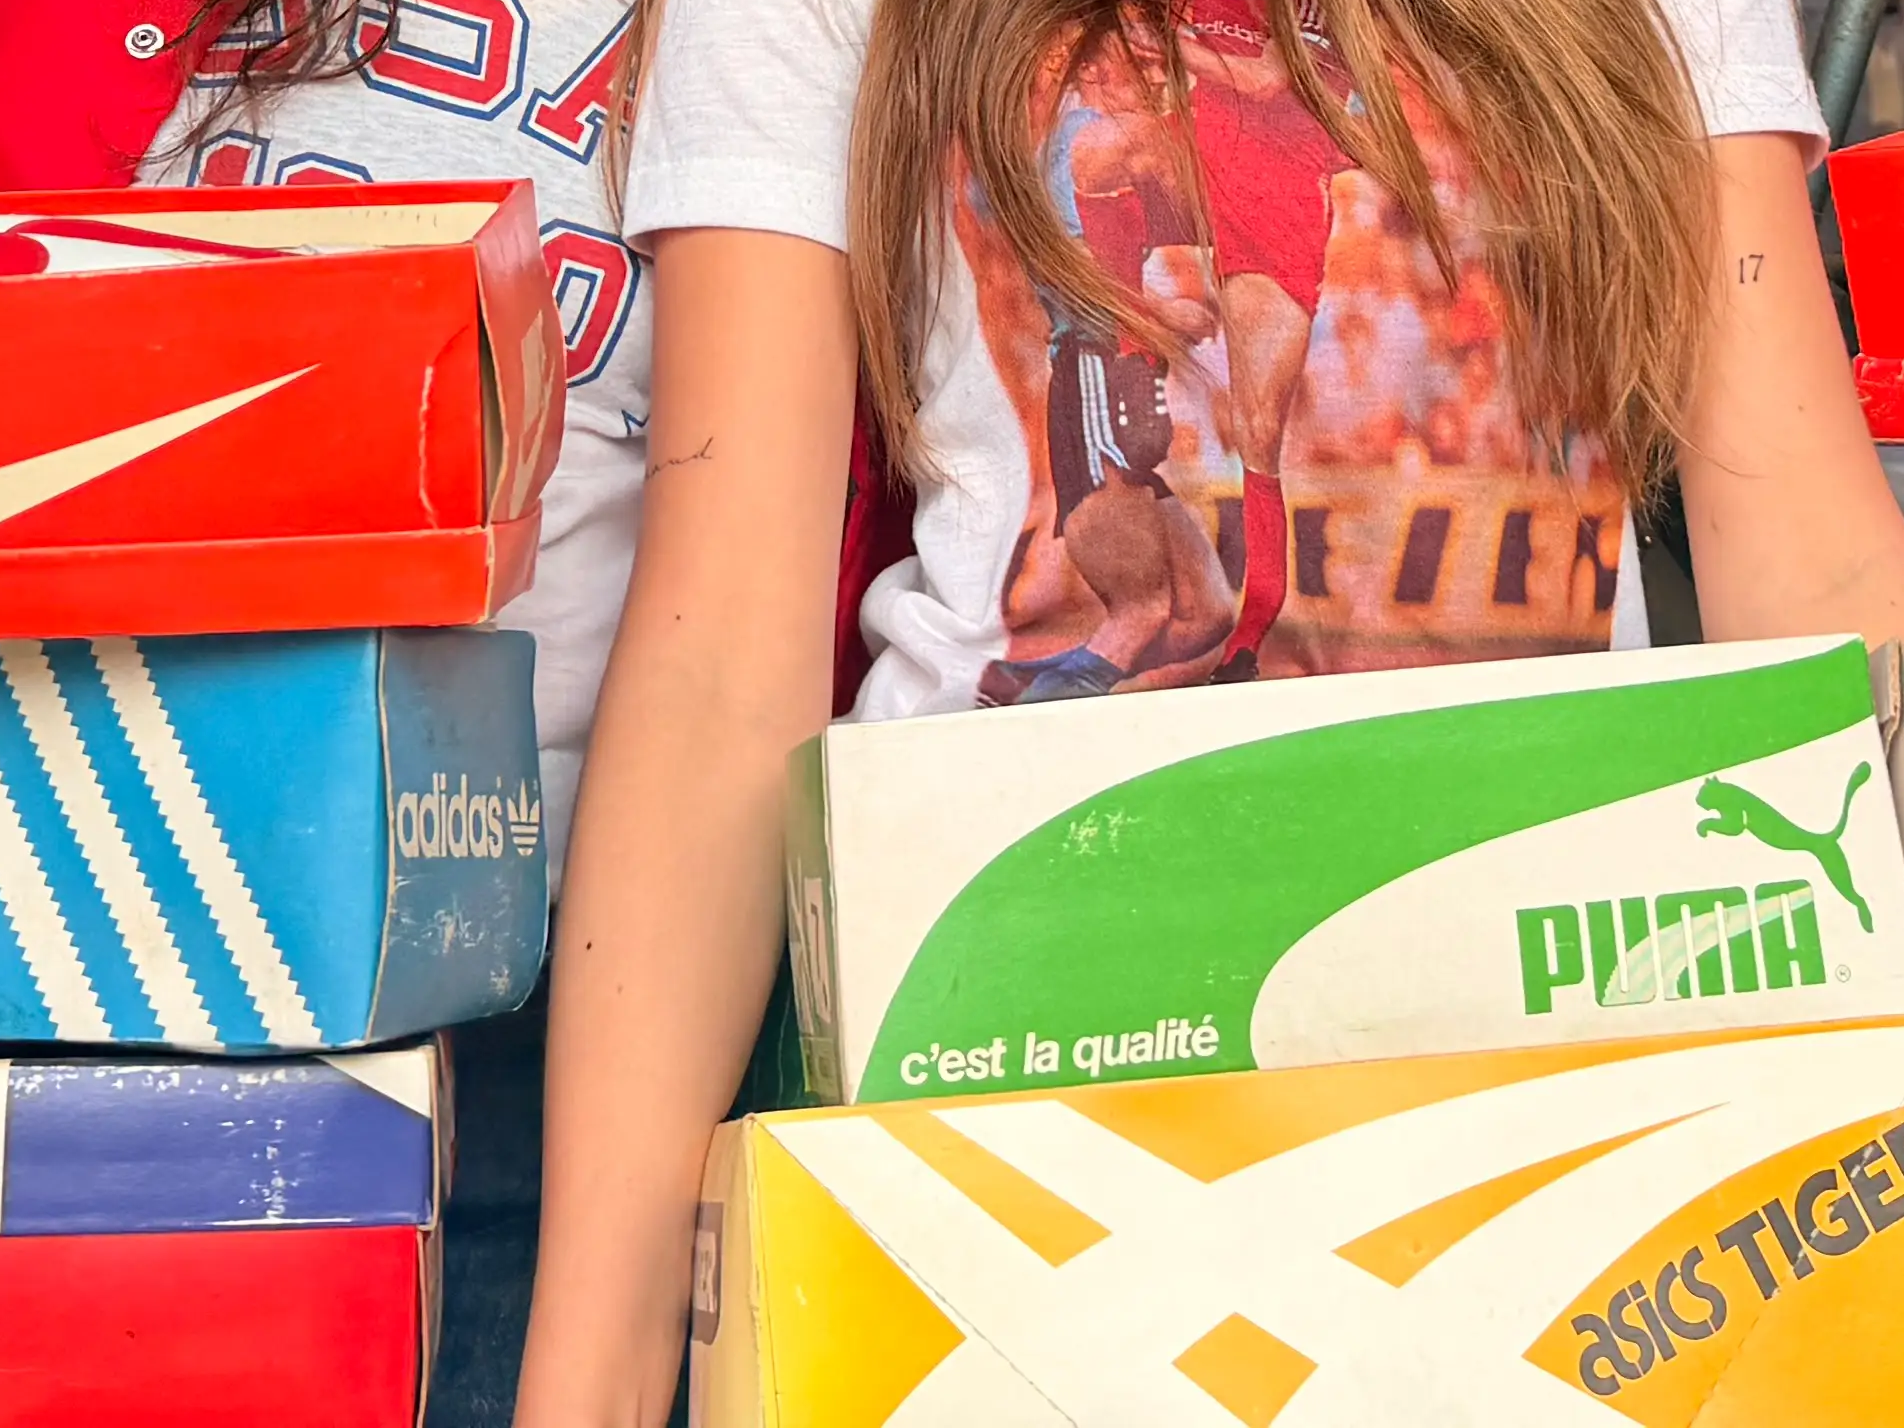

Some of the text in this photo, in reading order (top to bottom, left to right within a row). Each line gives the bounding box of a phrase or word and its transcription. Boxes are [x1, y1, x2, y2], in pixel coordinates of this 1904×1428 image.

[1739, 254, 1764, 284] 17
[396, 772, 504, 858] adidas
[1516, 879, 1827, 1015] PUMA
[900, 1014, 1220, 1086] c'est la qualité
[1570, 1245, 1728, 1396] asics
